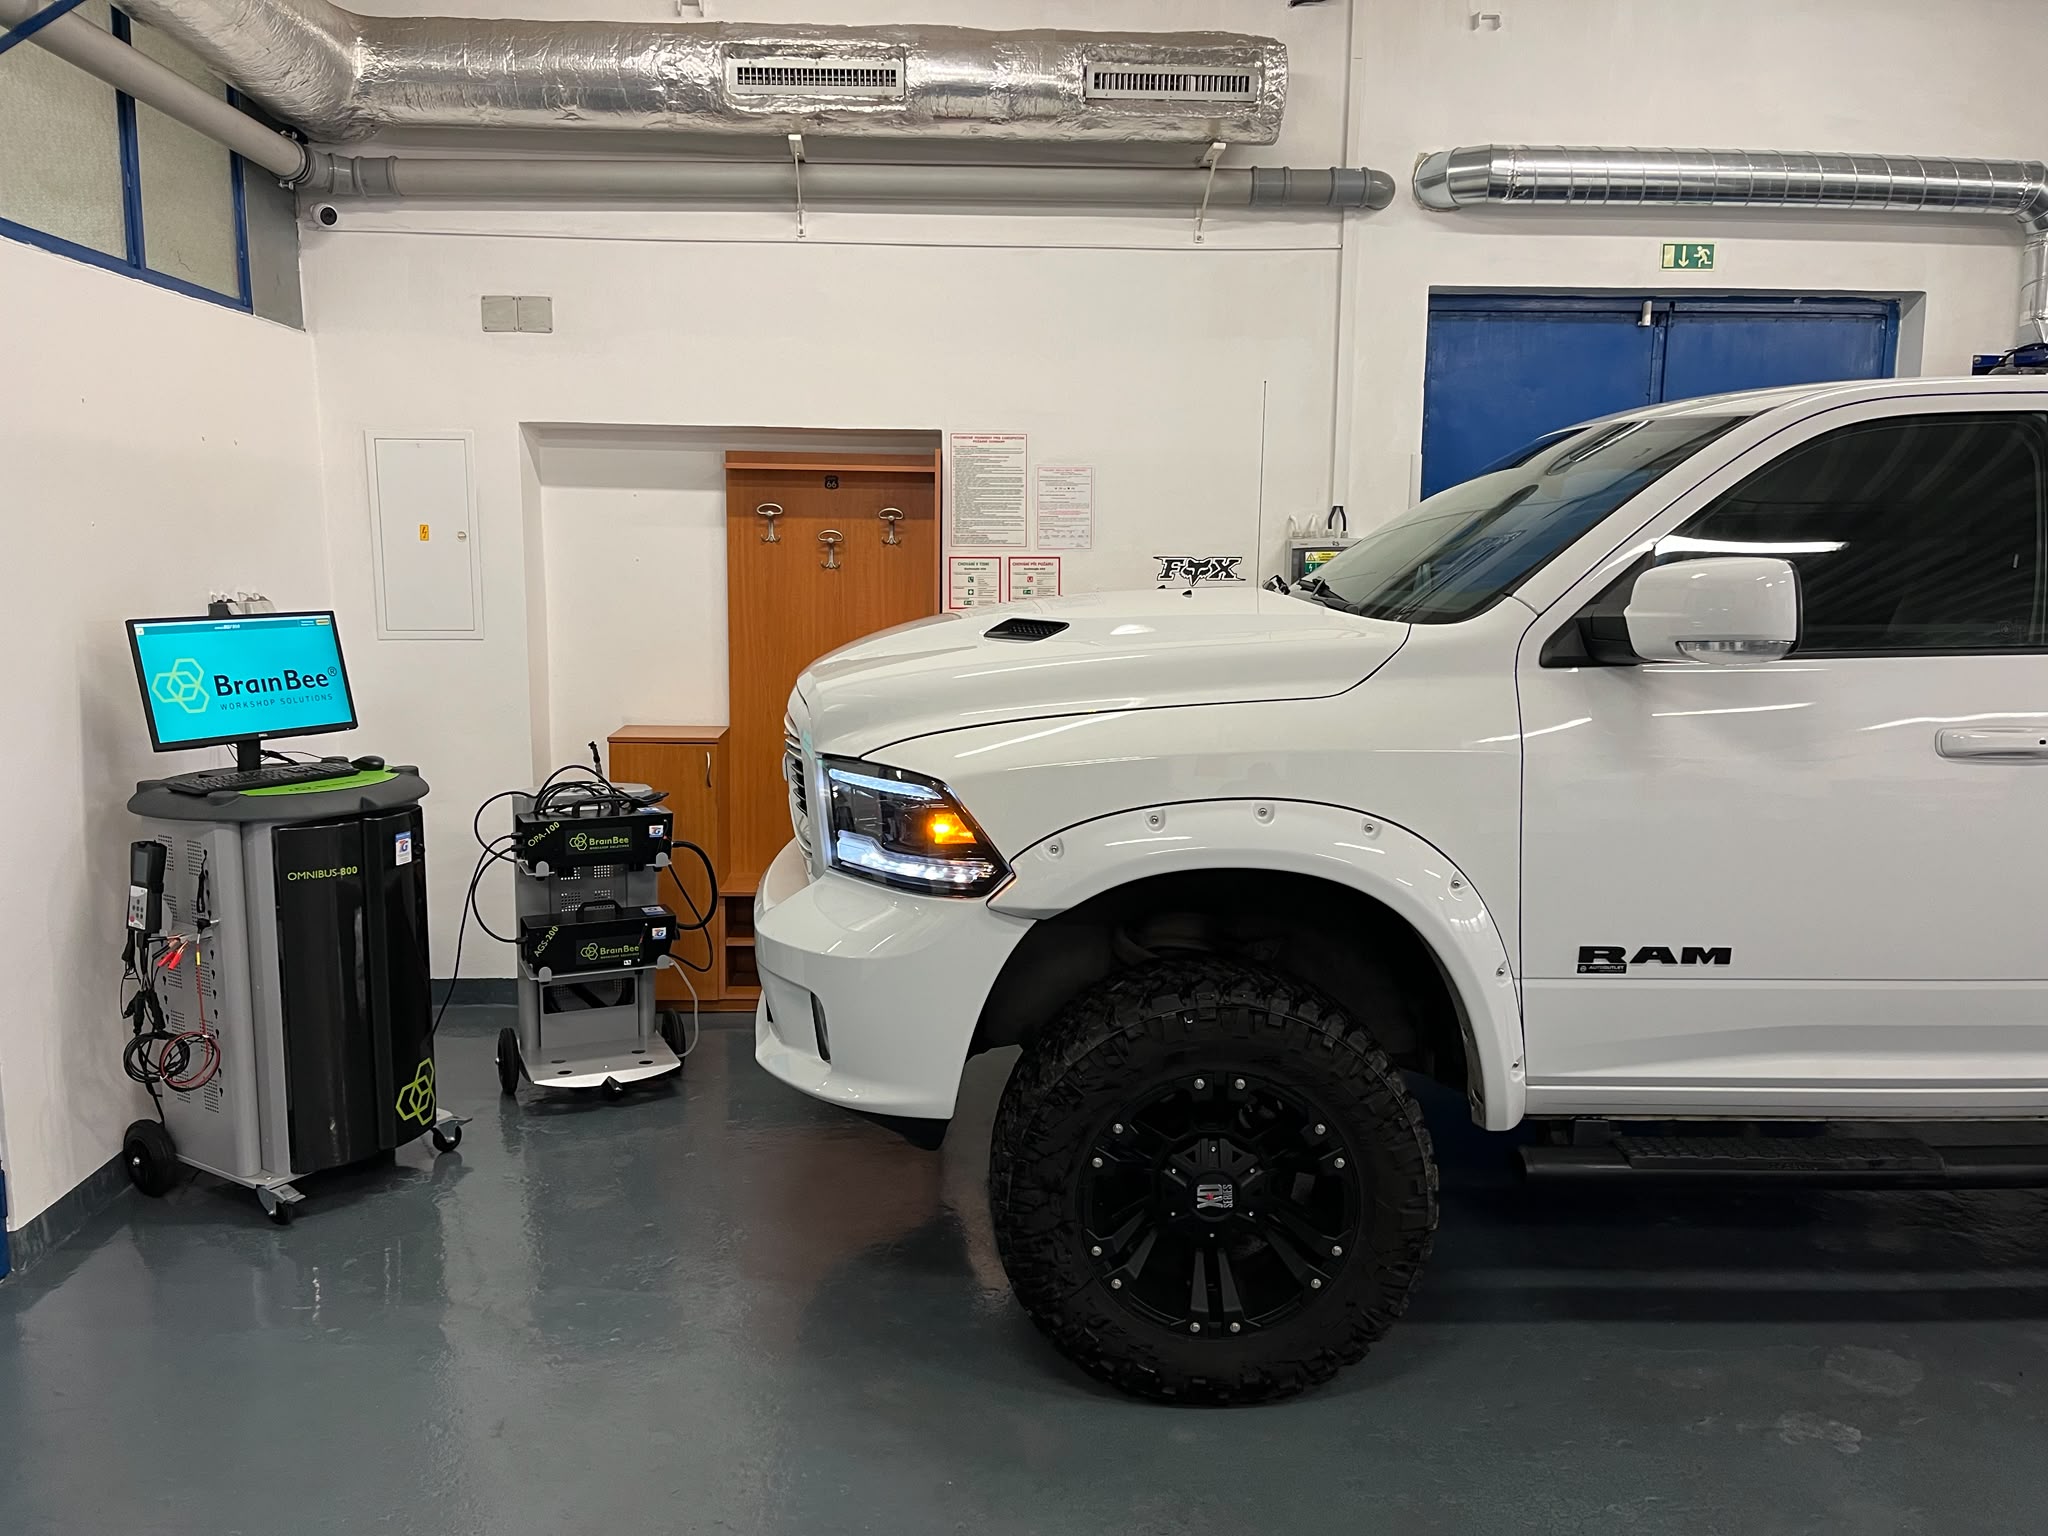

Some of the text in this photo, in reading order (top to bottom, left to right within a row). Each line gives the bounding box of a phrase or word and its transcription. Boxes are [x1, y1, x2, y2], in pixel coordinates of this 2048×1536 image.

[220, 693, 333, 711] WORKSHOP SOLUTIONS
[528, 821, 560, 847] OPA-100
[589, 836, 629, 846] BrainBee
[287, 866, 358, 881] OMNIBUS-800
[534, 926, 559, 957] AGS-200
[600, 945, 640, 955] BrainBee
[1578, 946, 1732, 964] RAM
[1223, 1184, 1233, 1208] SERIES
